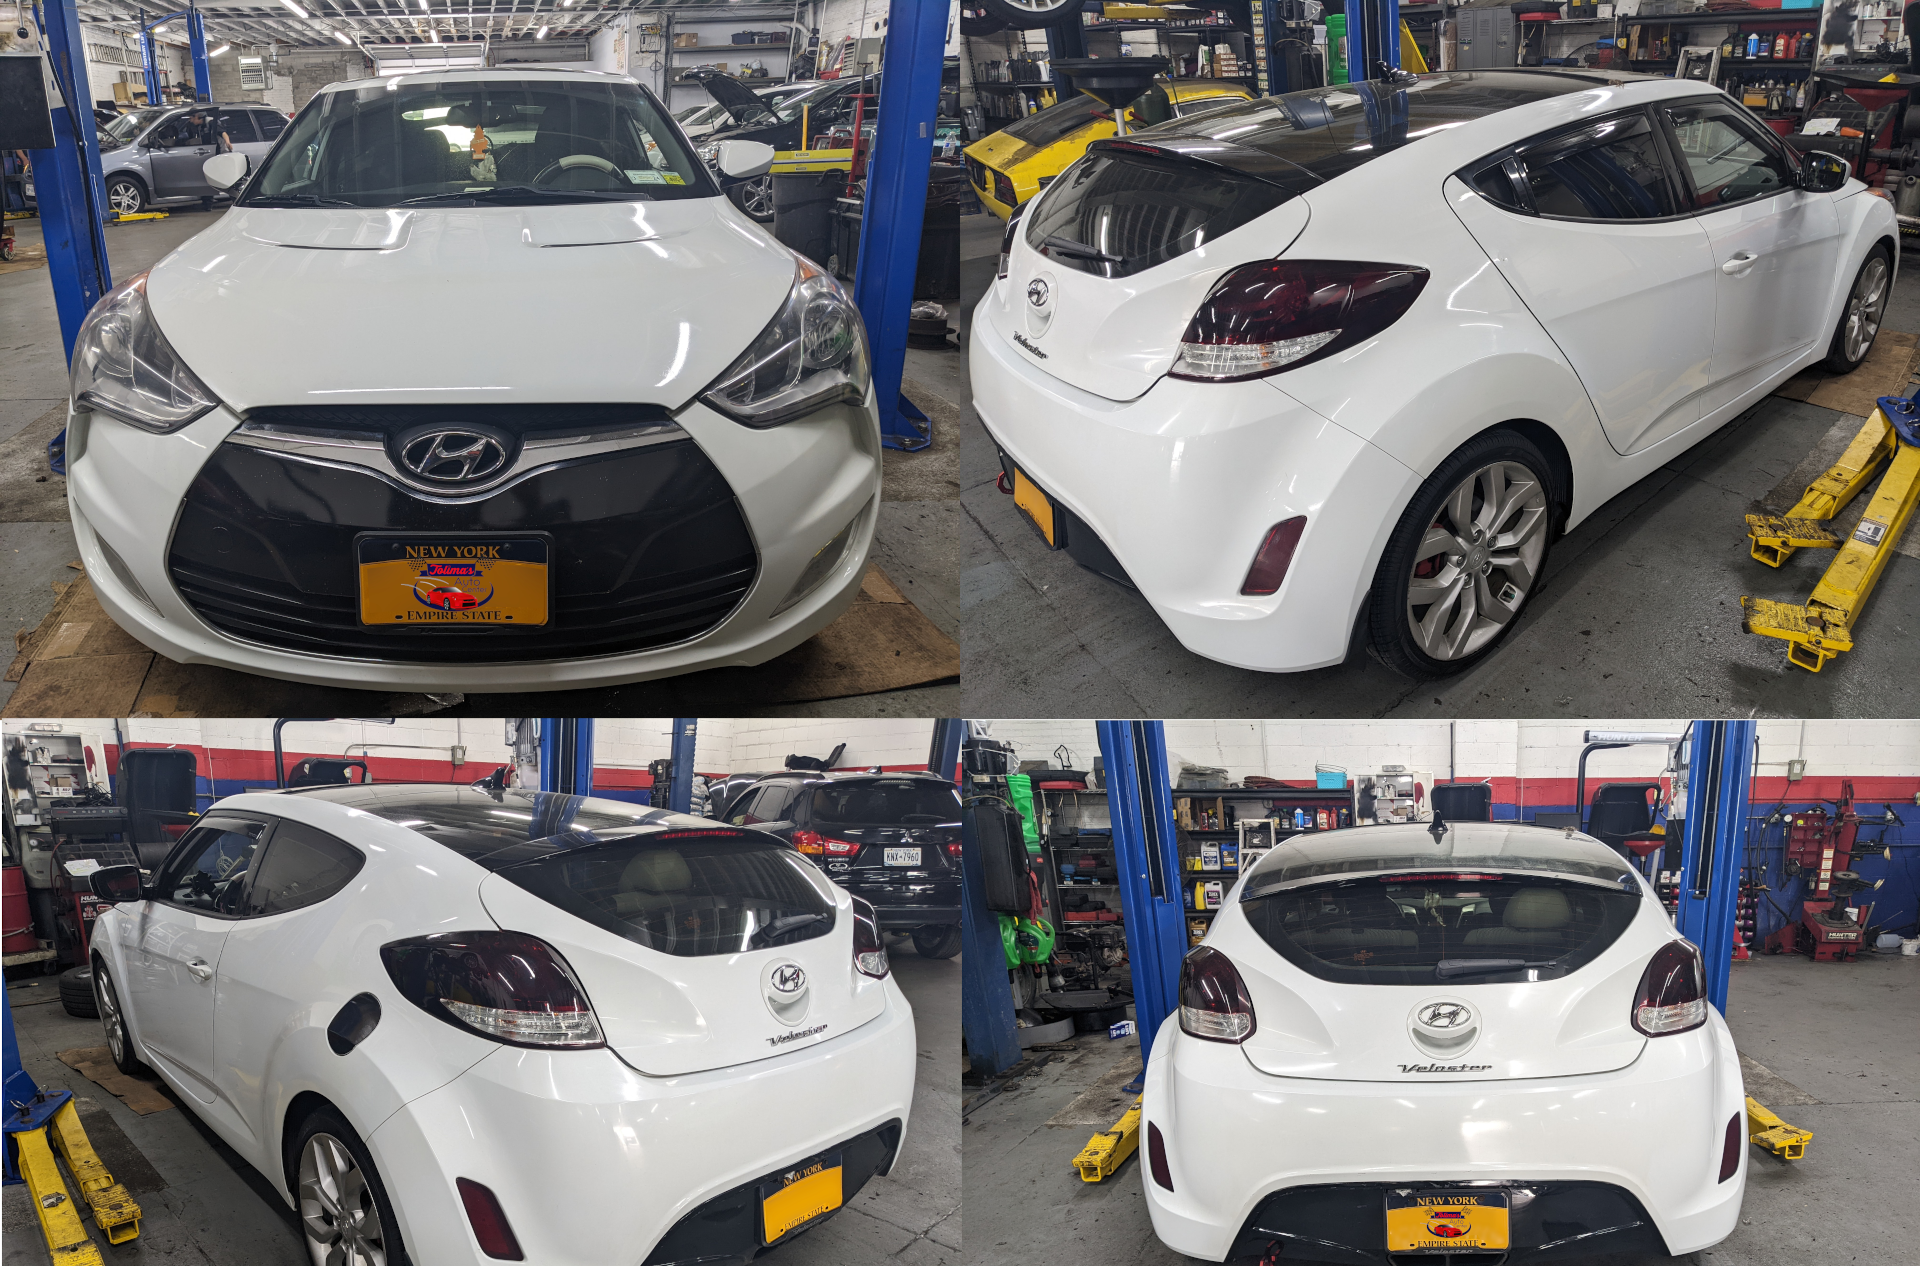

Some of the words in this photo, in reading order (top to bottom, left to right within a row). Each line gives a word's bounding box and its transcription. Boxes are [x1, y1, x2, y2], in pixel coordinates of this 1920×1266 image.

[405, 545, 449, 559] NEW
[452, 545, 501, 559] YORK
[407, 610, 458, 621] EMPIRE
[462, 610, 502, 621] STATE
[1397, 1063, 1493, 1073] Veloster
[802, 1161, 823, 1177] YORK
[1416, 1196, 1445, 1206] NEW
[1447, 1196, 1478, 1205] YORK
[785, 1215, 806, 1231] EMPIRE
[807, 1205, 825, 1220] STATE
[1453, 1239, 1479, 1247] STATE
